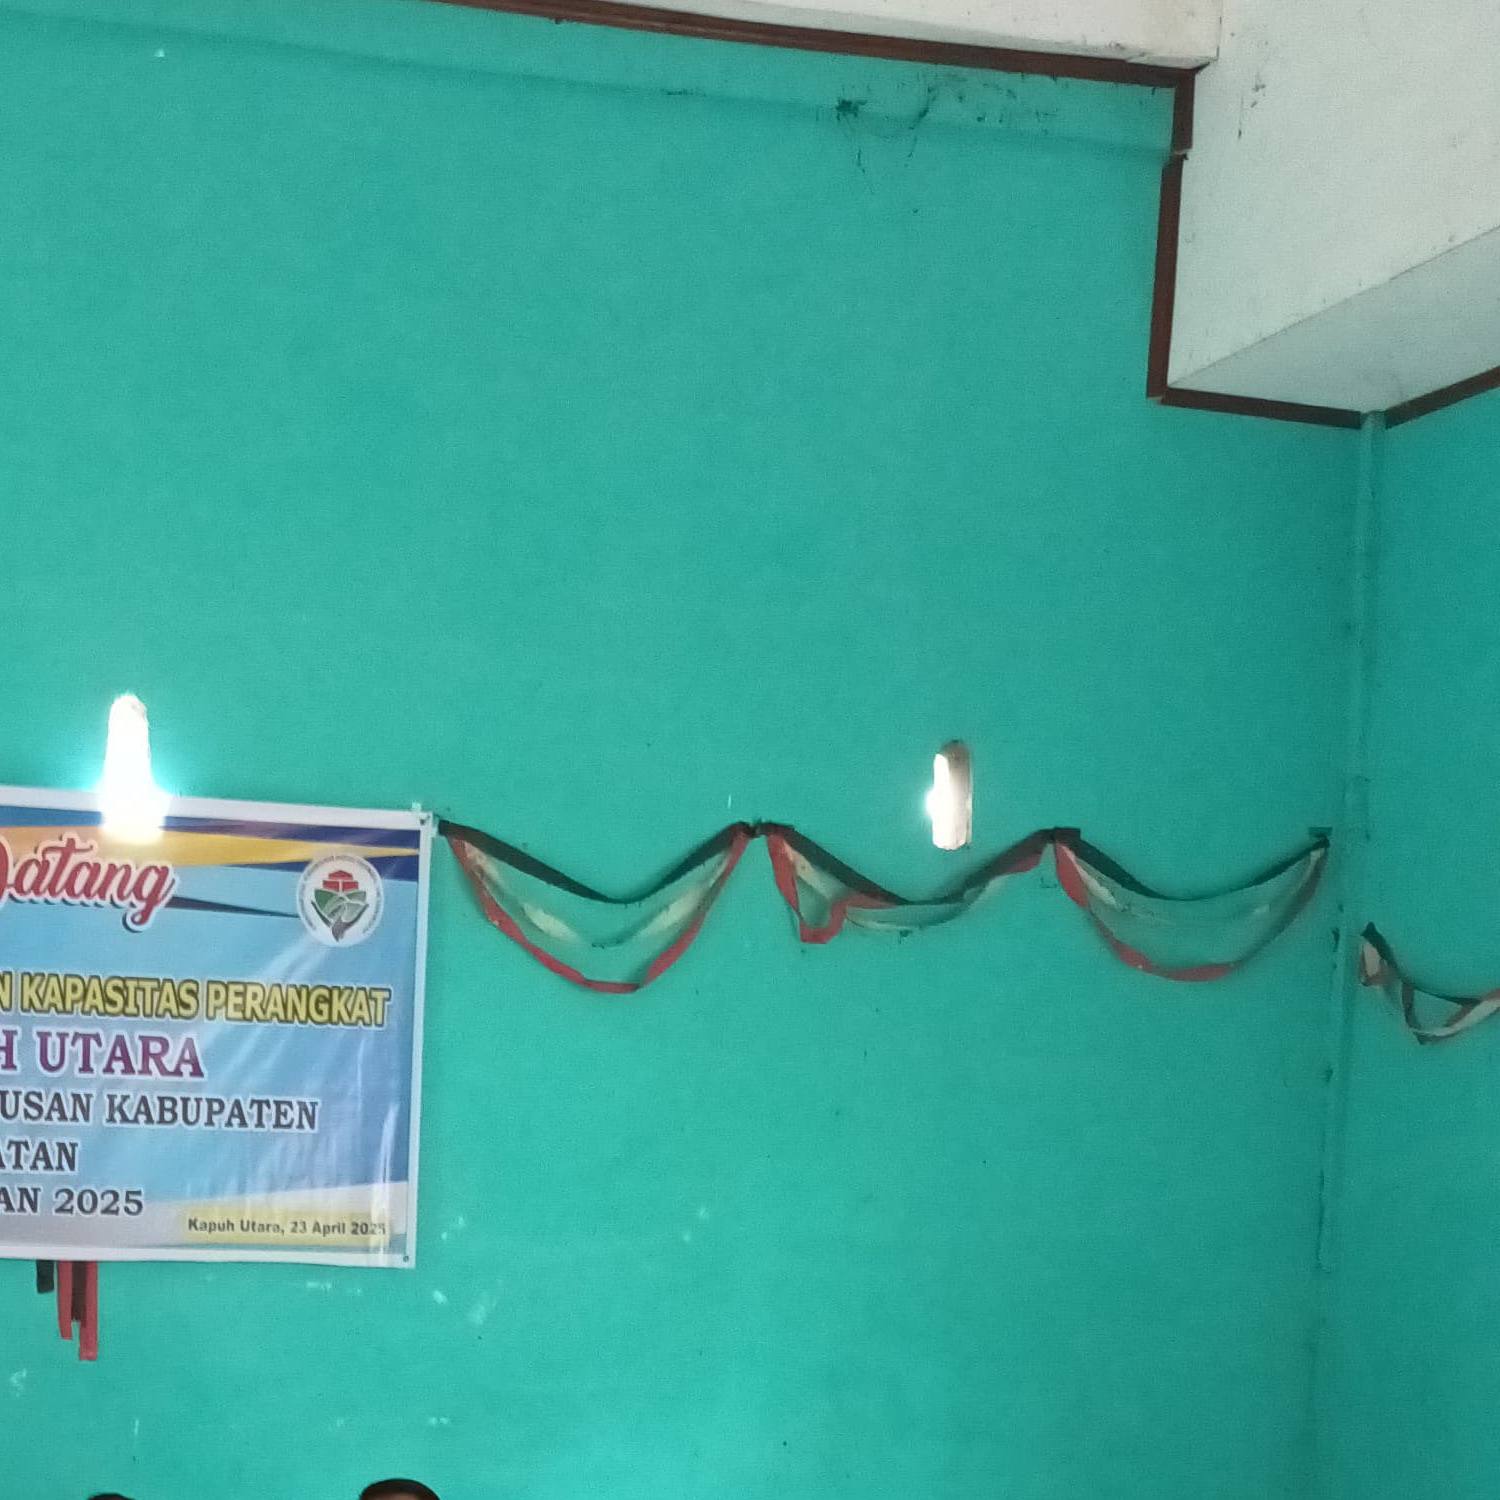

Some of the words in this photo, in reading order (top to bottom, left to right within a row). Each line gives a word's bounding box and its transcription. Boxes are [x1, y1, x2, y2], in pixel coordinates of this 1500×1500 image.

[20, 971, 201, 1021] KAPASITAS
[206, 981, 391, 1027] PERANGKAT
[36, 1031, 205, 1078] UTARA
[105, 1093, 319, 1131] KABUPATEN
[53, 1189, 144, 1217] 2025
[187, 1217, 235, 1235] Kapuh
[240, 1218, 285, 1236] Utara,
[290, 1220, 307, 1234] 23
[312, 1221, 346, 1238] April
